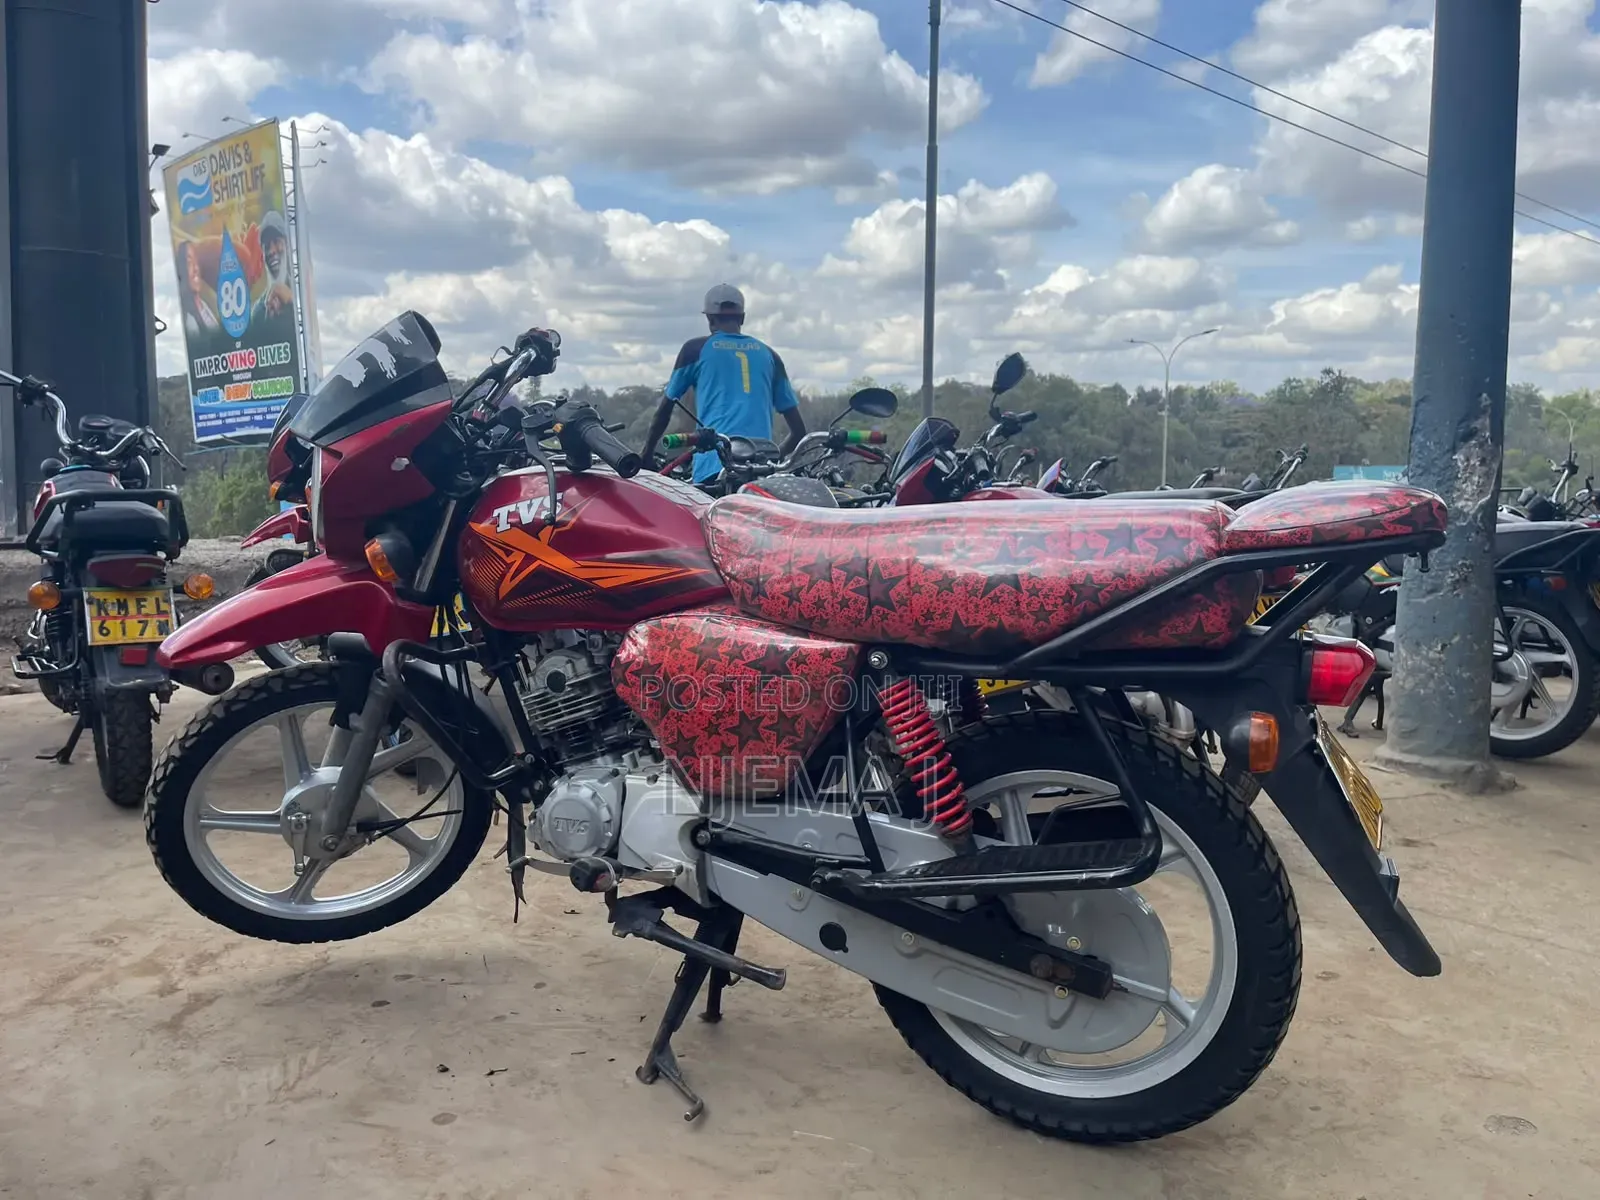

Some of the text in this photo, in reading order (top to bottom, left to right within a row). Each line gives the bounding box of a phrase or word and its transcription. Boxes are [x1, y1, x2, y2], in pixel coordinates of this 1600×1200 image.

[208, 140, 253, 177] DAVIS &
[212, 163, 266, 204] SHIRTLIFF
[221, 278, 247, 318] 80
[194, 341, 292, 379] IMPROVING LIVES
[735, 351, 751, 393] 1
[492, 491, 564, 533] TVS
[553, 817, 592, 836] TVS
